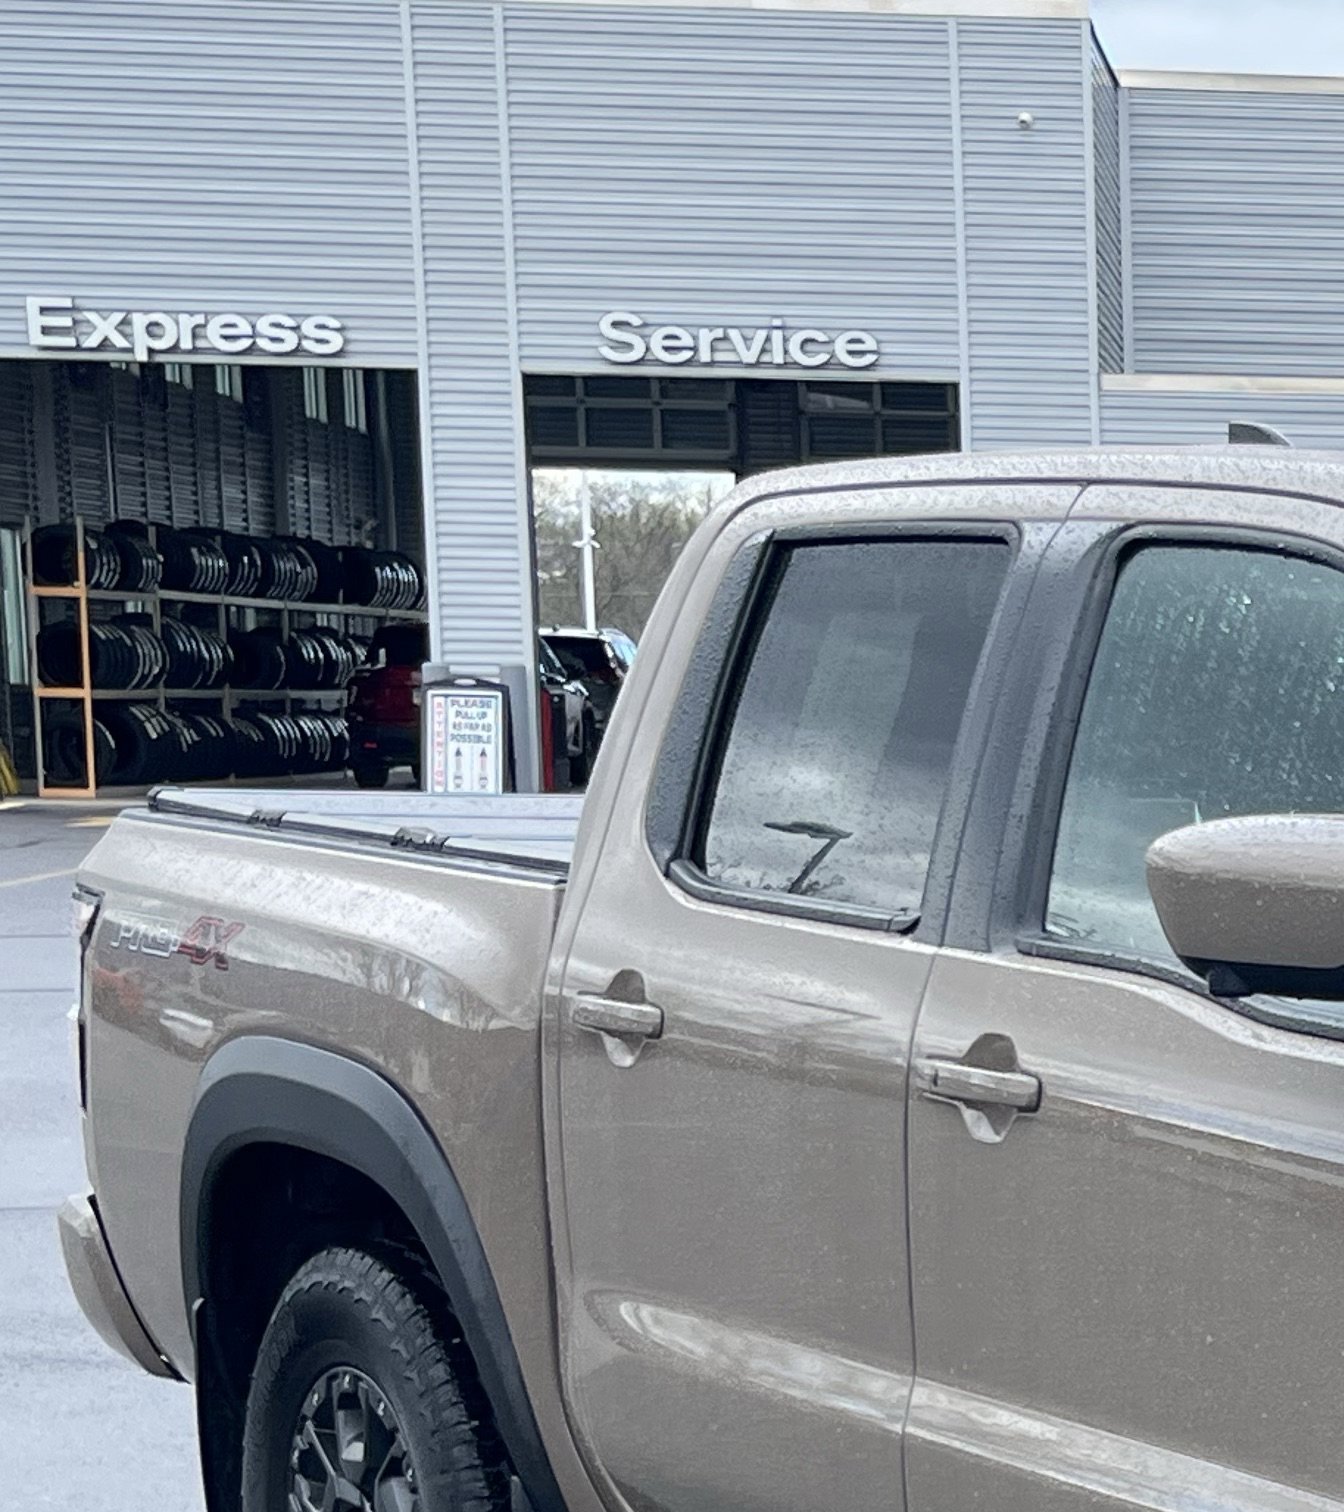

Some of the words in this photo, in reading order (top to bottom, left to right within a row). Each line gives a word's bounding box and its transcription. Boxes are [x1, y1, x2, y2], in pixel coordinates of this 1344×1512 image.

[25, 295, 346, 363] Express
[598, 310, 880, 368] Service
[450, 698, 493, 709] PLEASE
[450, 733, 493, 744] POSSIBLE
